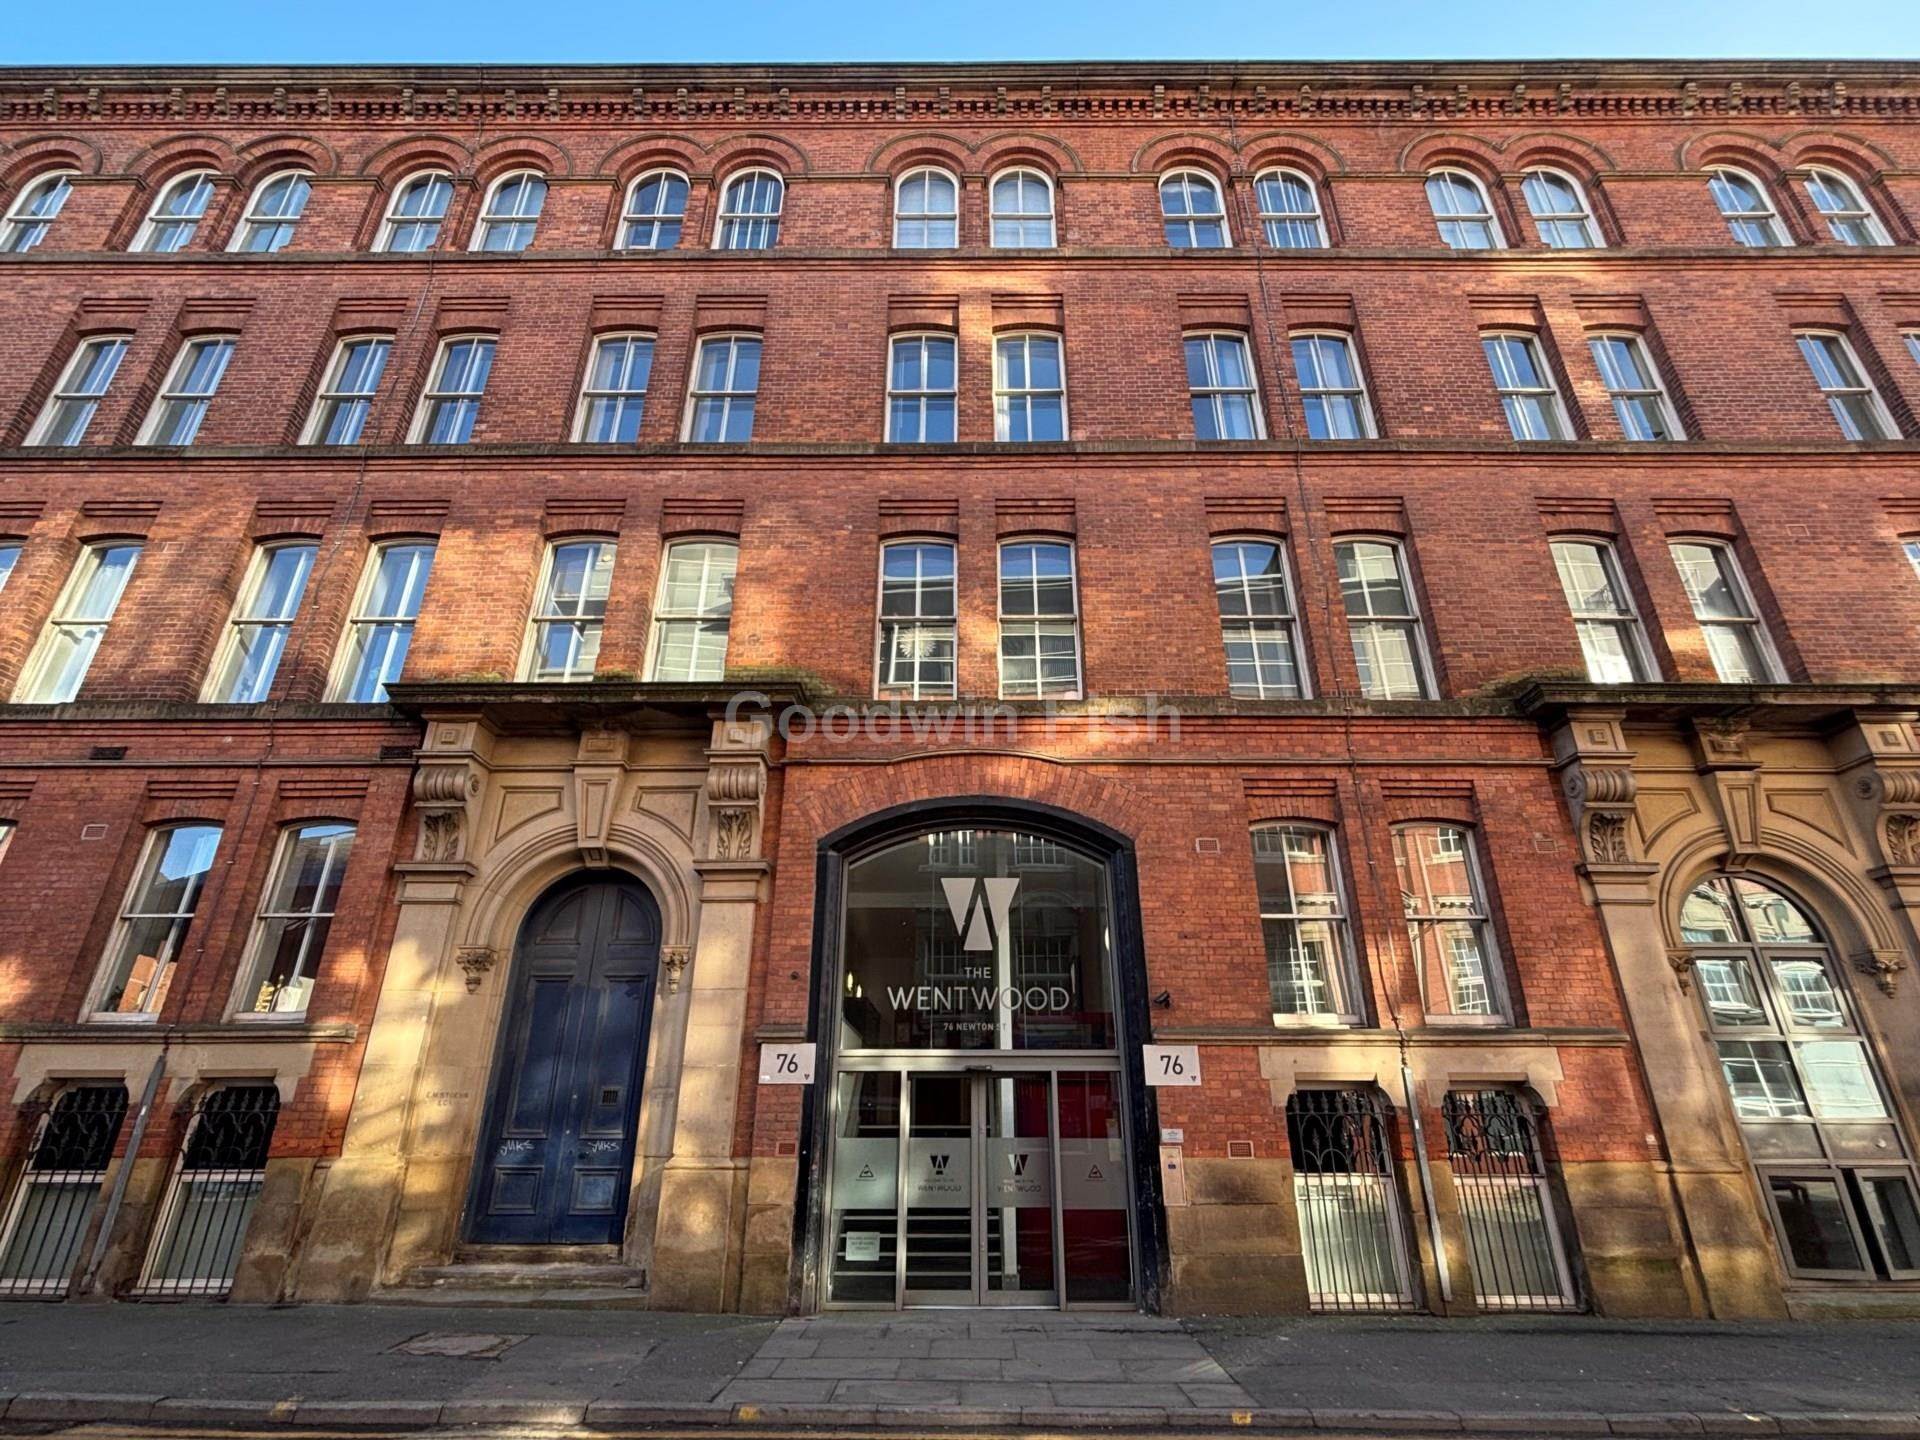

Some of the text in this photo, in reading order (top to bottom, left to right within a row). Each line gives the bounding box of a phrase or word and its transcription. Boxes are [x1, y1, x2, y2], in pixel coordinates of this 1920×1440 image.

[965, 967, 992, 979] THE
[887, 986, 1070, 1011] WENTWOOD
[943, 1023, 954, 1031] 76
[956, 1023, 994, 1031] NEWTON
[776, 1053, 799, 1074] 76
[1160, 1055, 1184, 1076] 76
